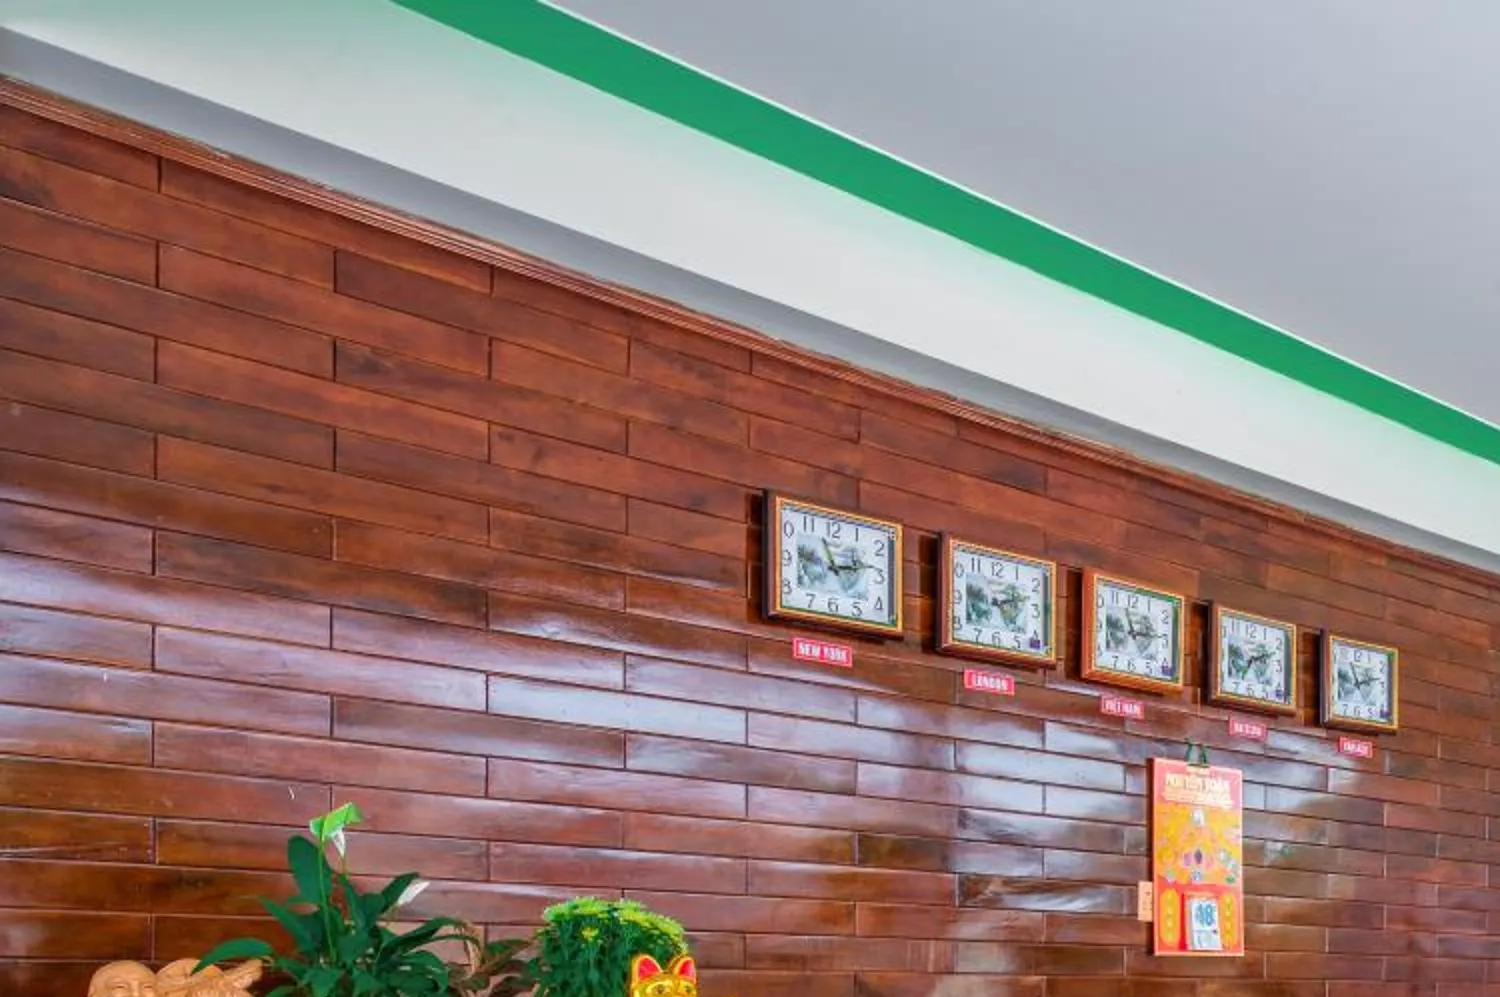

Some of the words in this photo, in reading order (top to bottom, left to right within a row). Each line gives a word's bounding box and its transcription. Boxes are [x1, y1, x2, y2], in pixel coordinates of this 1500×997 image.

[803, 515, 815, 533] 11
[825, 521, 841, 539] 12
[873, 540, 885, 557] 2
[782, 549, 792, 566] 9
[971, 557, 981, 573] 11
[873, 568, 885, 585] 3
[991, 561, 1004, 577] 12
[1031, 577, 1040, 592] 2
[805, 593, 816, 608] 7
[827, 598, 839, 612] 6
[874, 596, 883, 611] 4
[1111, 591, 1119, 604] 11
[1127, 594, 1139, 608] 12
[851, 601, 862, 617] 5
[1031, 604, 1040, 618] 3
[1161, 609, 1169, 624] 2
[973, 627, 983, 643] 7
[991, 631, 1000, 645] 6
[1245, 624, 1257, 638] 12
[1014, 635, 1021, 648] 5
[1111, 655, 1119, 669] 7
